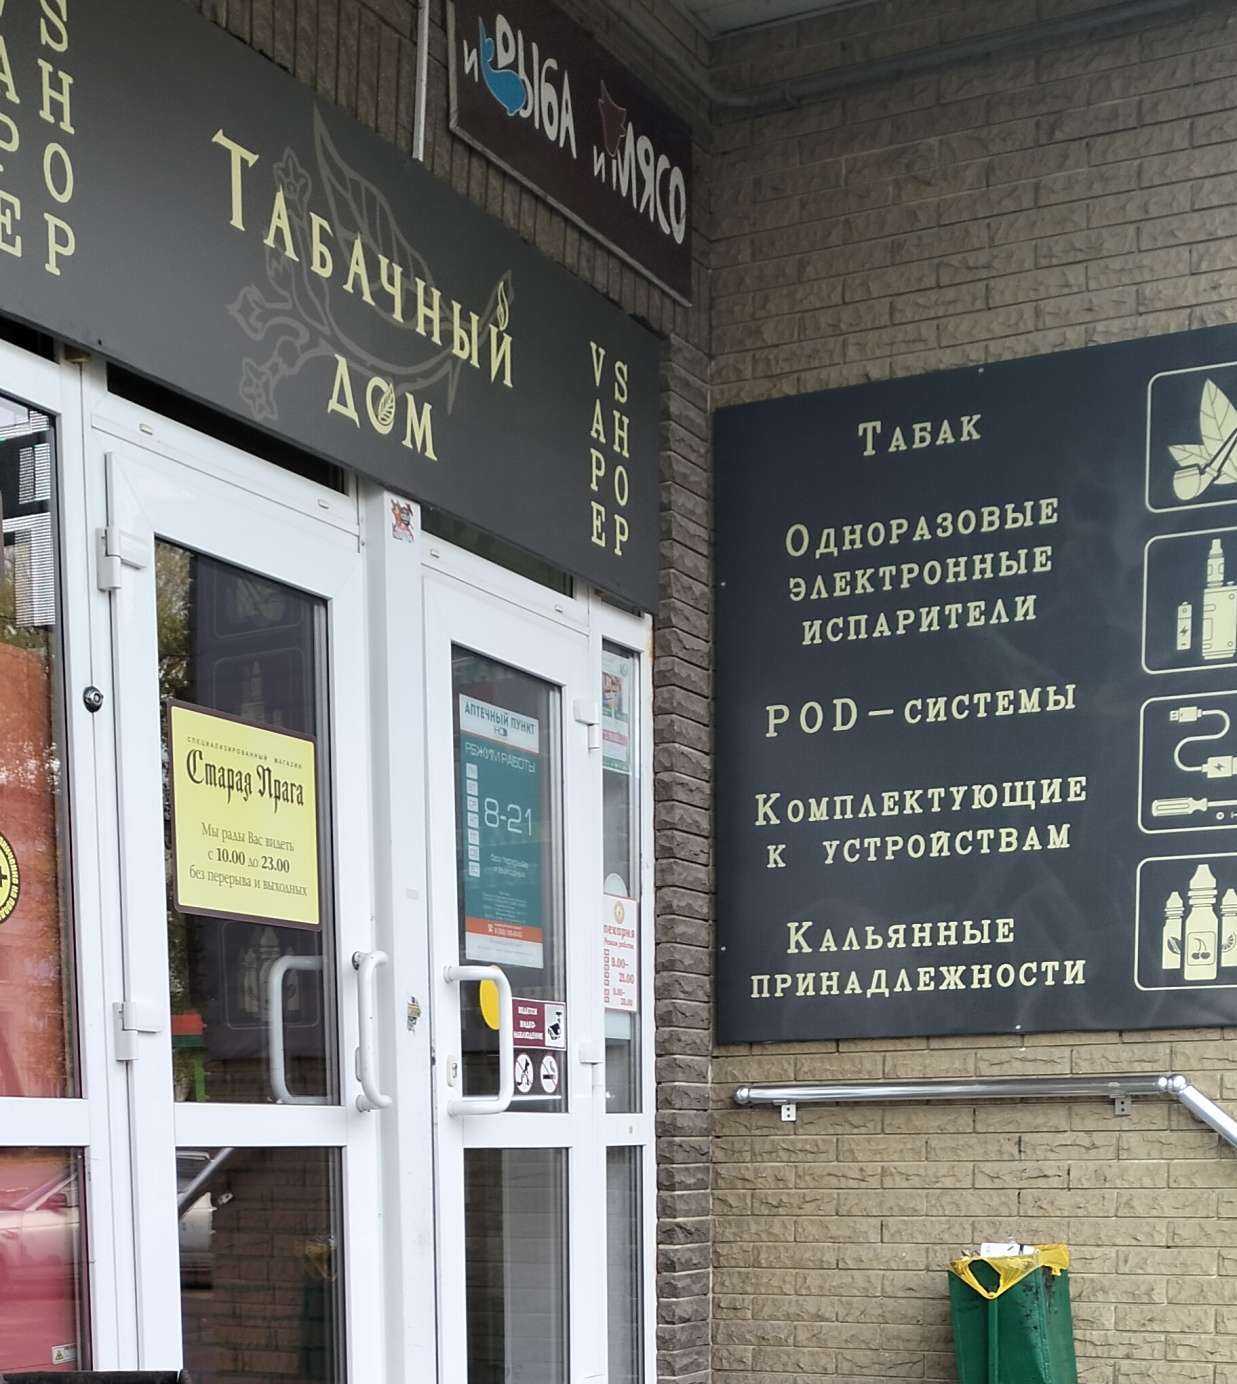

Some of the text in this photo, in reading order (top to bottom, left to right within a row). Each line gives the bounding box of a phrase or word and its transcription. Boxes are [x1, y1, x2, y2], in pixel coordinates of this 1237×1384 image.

[327, 353, 438, 462] ДОМ
[589, 341, 607, 548] VAPE
[612, 360, 630, 556] SHOP
[789, 545, 1054, 602] ЭЛЕКТРОННЫЕ
[802, 595, 1038, 646] ИСПАРИТЕЛИ
[464, 701, 509, 726] АПТЕЧНЫЙ
[511, 717, 535, 734] ПУНКТ
[186, 749, 304, 814] Старая Прага
[501, 752, 536, 773] РАБОТЫ
[201, 822, 295, 851] Мы рады Вас видеть
[484, 797, 532, 837] 8-21
[216, 847, 246, 866] 10.00
[248, 857, 259, 867] до
[261, 855, 290, 873] 23.00
[766, 823, 1072, 868] К УСТРОЙСТВАМ
[189, 864, 205, 880] без
[208, 870, 251, 889] перерыва
[263, 880, 308, 896] выходных
[750, 959, 1087, 1000] ПРИНАДЛЕЖНОСТИ
